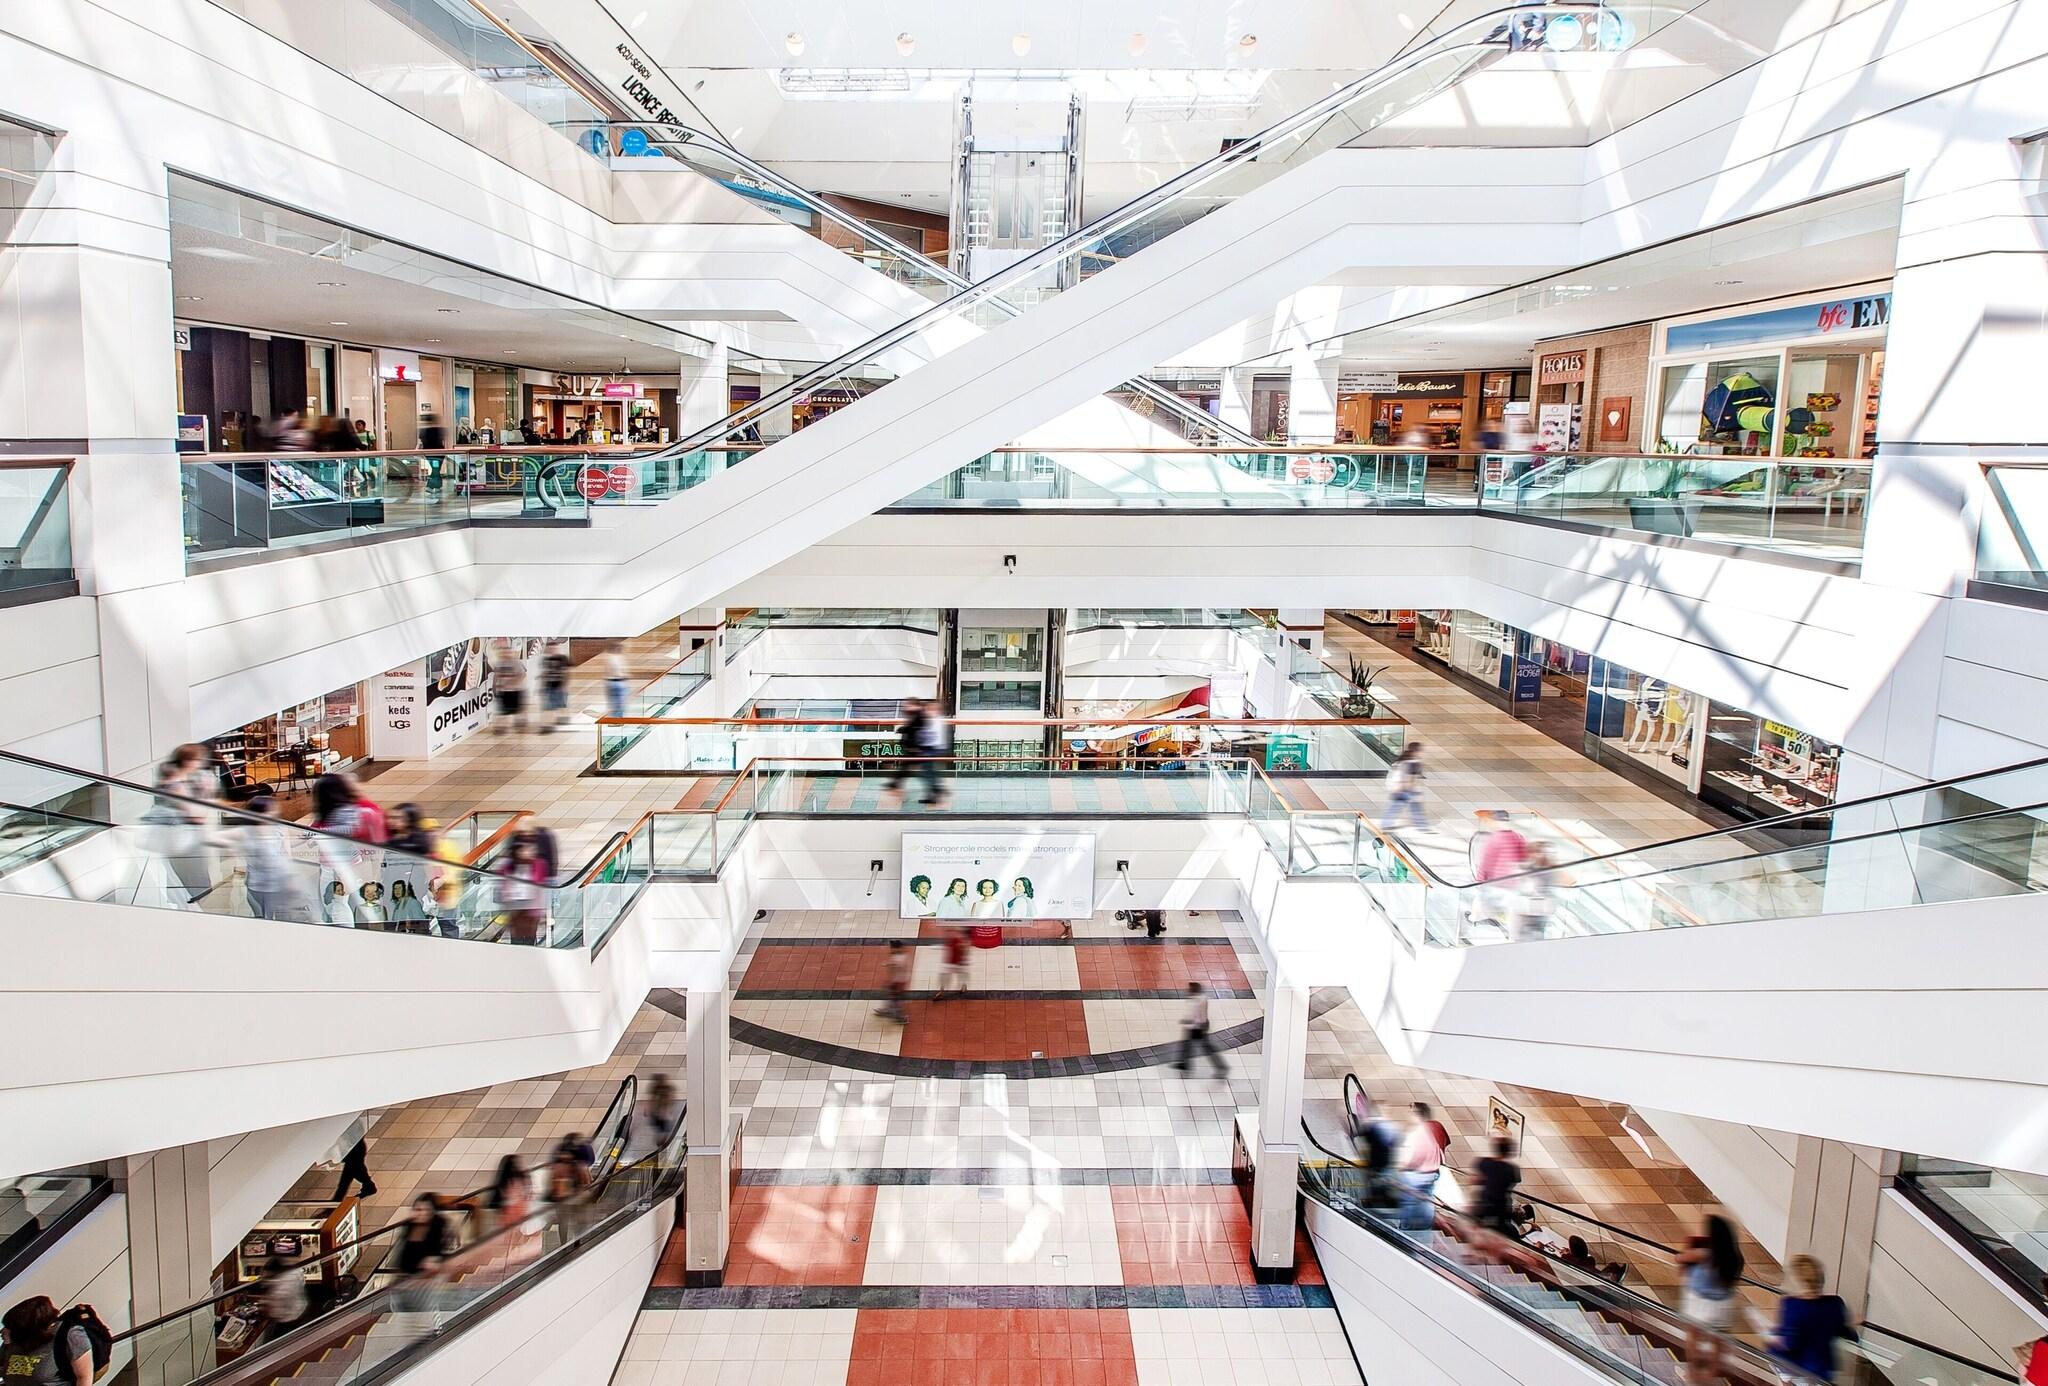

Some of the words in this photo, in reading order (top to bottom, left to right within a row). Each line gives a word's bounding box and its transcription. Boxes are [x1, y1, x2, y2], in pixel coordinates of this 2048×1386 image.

[616, 43, 652, 80] ACCU-SEARCH
[621, 75, 662, 114] LICENCE
[1817, 303, 1848, 333] bfc
[1543, 355, 1582, 374] PEOPLES
[1415, 380, 1456, 392] Bauer
[388, 704, 410, 715] keds
[388, 719, 411, 729] UGG
[924, 844, 959, 853] Stronger
[960, 844, 976, 853] role
[977, 844, 1007, 853] models
[1033, 846, 1069, 854] stronger
